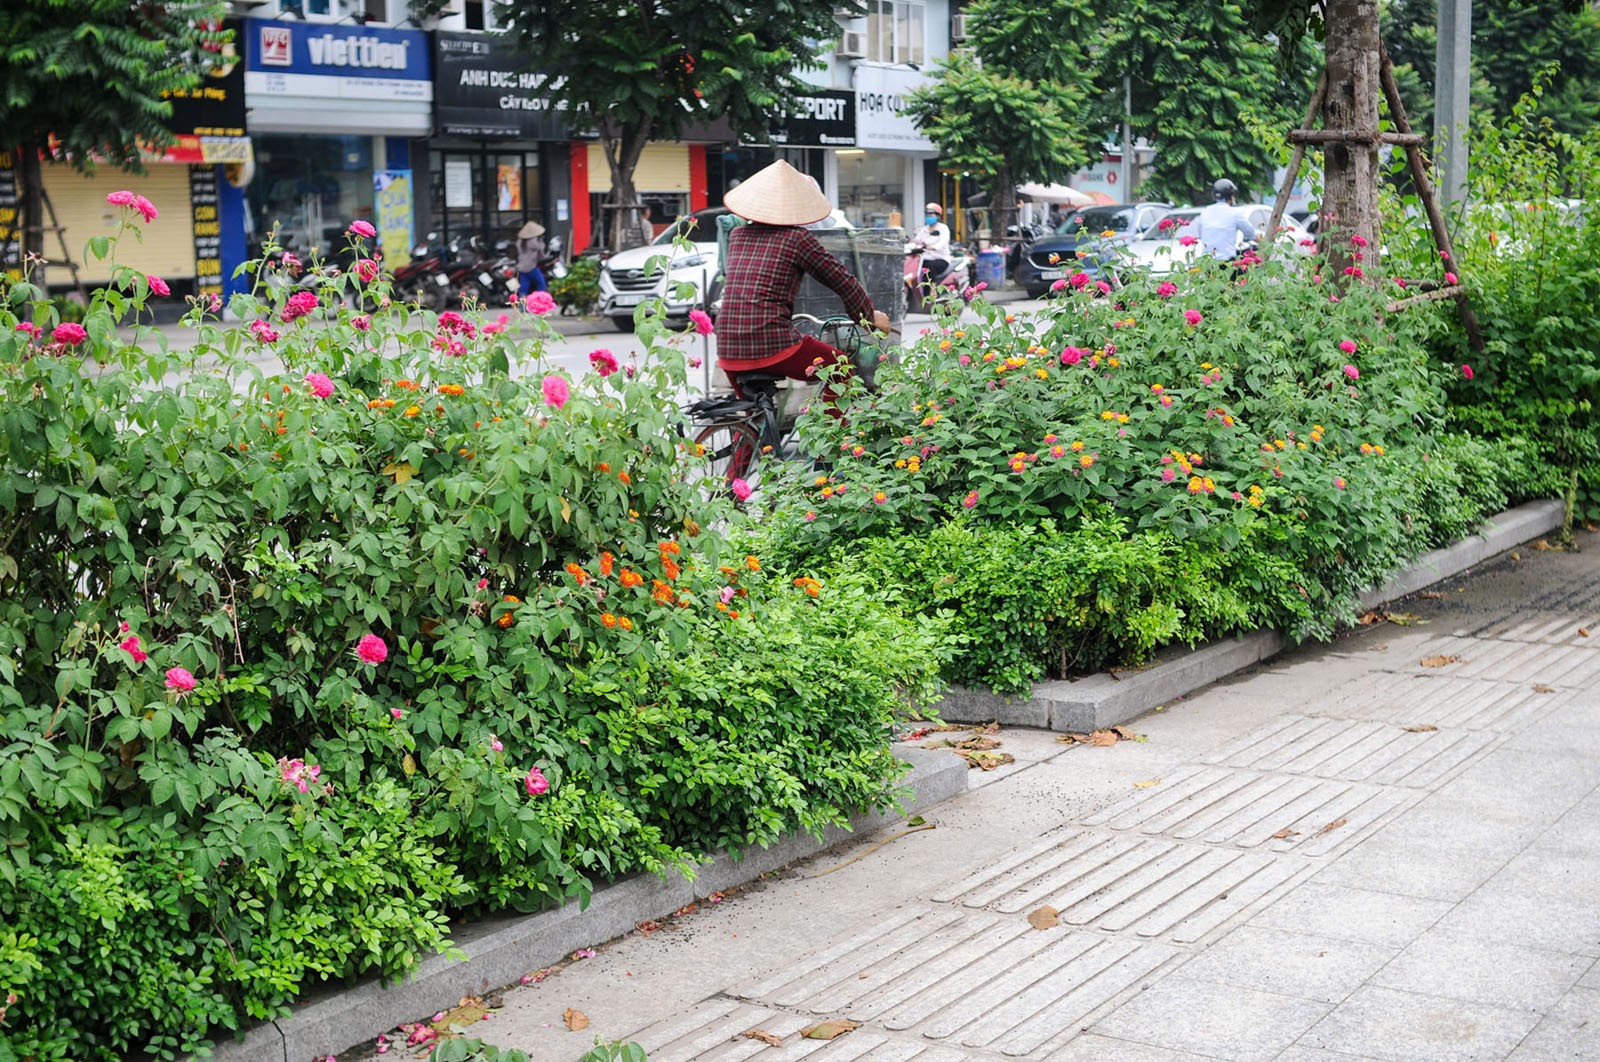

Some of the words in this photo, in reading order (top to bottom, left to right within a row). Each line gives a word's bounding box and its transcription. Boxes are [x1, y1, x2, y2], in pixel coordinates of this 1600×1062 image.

[307, 33, 407, 70] viettien
[460, 69, 489, 86] ANH
[500, 94, 521, 109] CÂY
